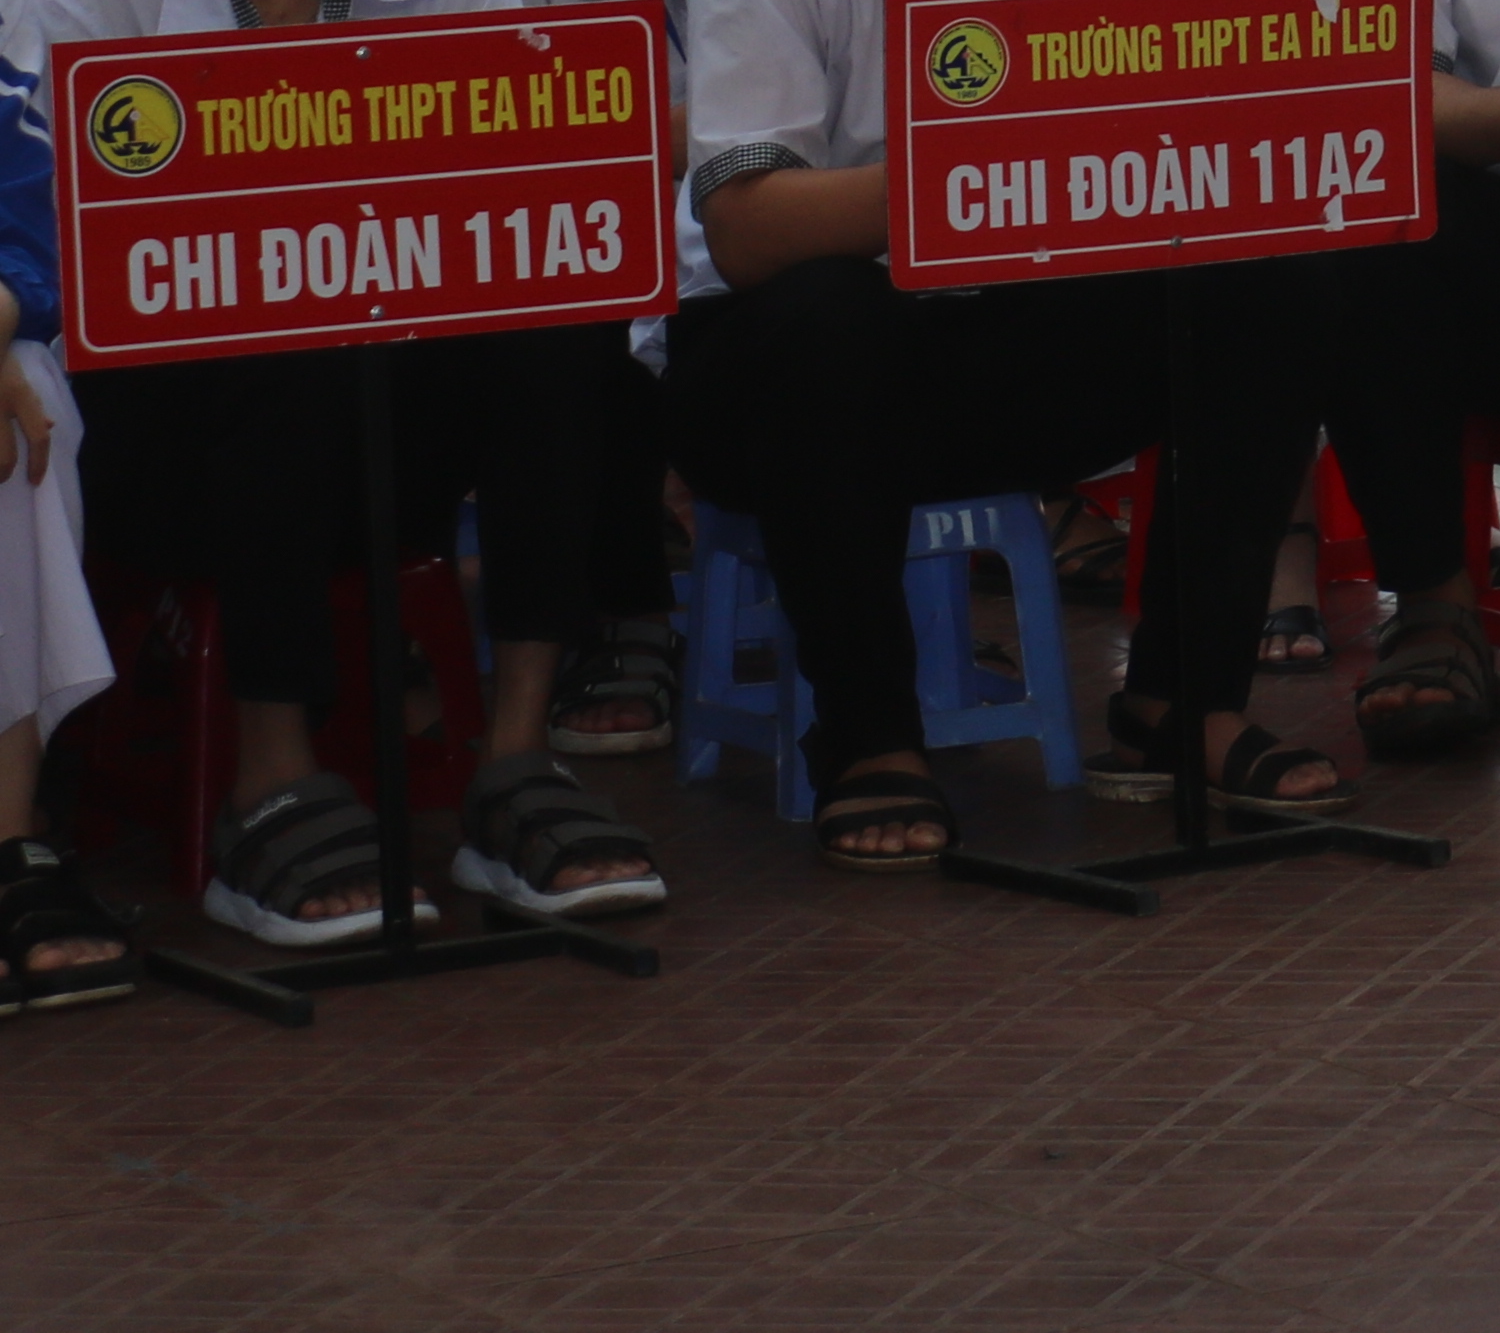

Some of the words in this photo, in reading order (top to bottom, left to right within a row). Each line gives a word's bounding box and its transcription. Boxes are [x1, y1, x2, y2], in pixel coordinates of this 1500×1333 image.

[1027, 16, 1162, 81] TRƯỜNG
[1172, 17, 1251, 69] THPT
[1261, 12, 1301, 62] EA
[197, 79, 352, 155] TRƯỜNG
[364, 81, 456, 142] THPT
[469, 76, 518, 134] EA
[946, 159, 1047, 232] CHI
[1066, 134, 1230, 222] ĐOÀN
[1250, 129, 1386, 203] 11A2
[128, 232, 237, 315] CHI
[258, 204, 441, 302] ĐOÀN
[465, 199, 622, 283] 11A3
